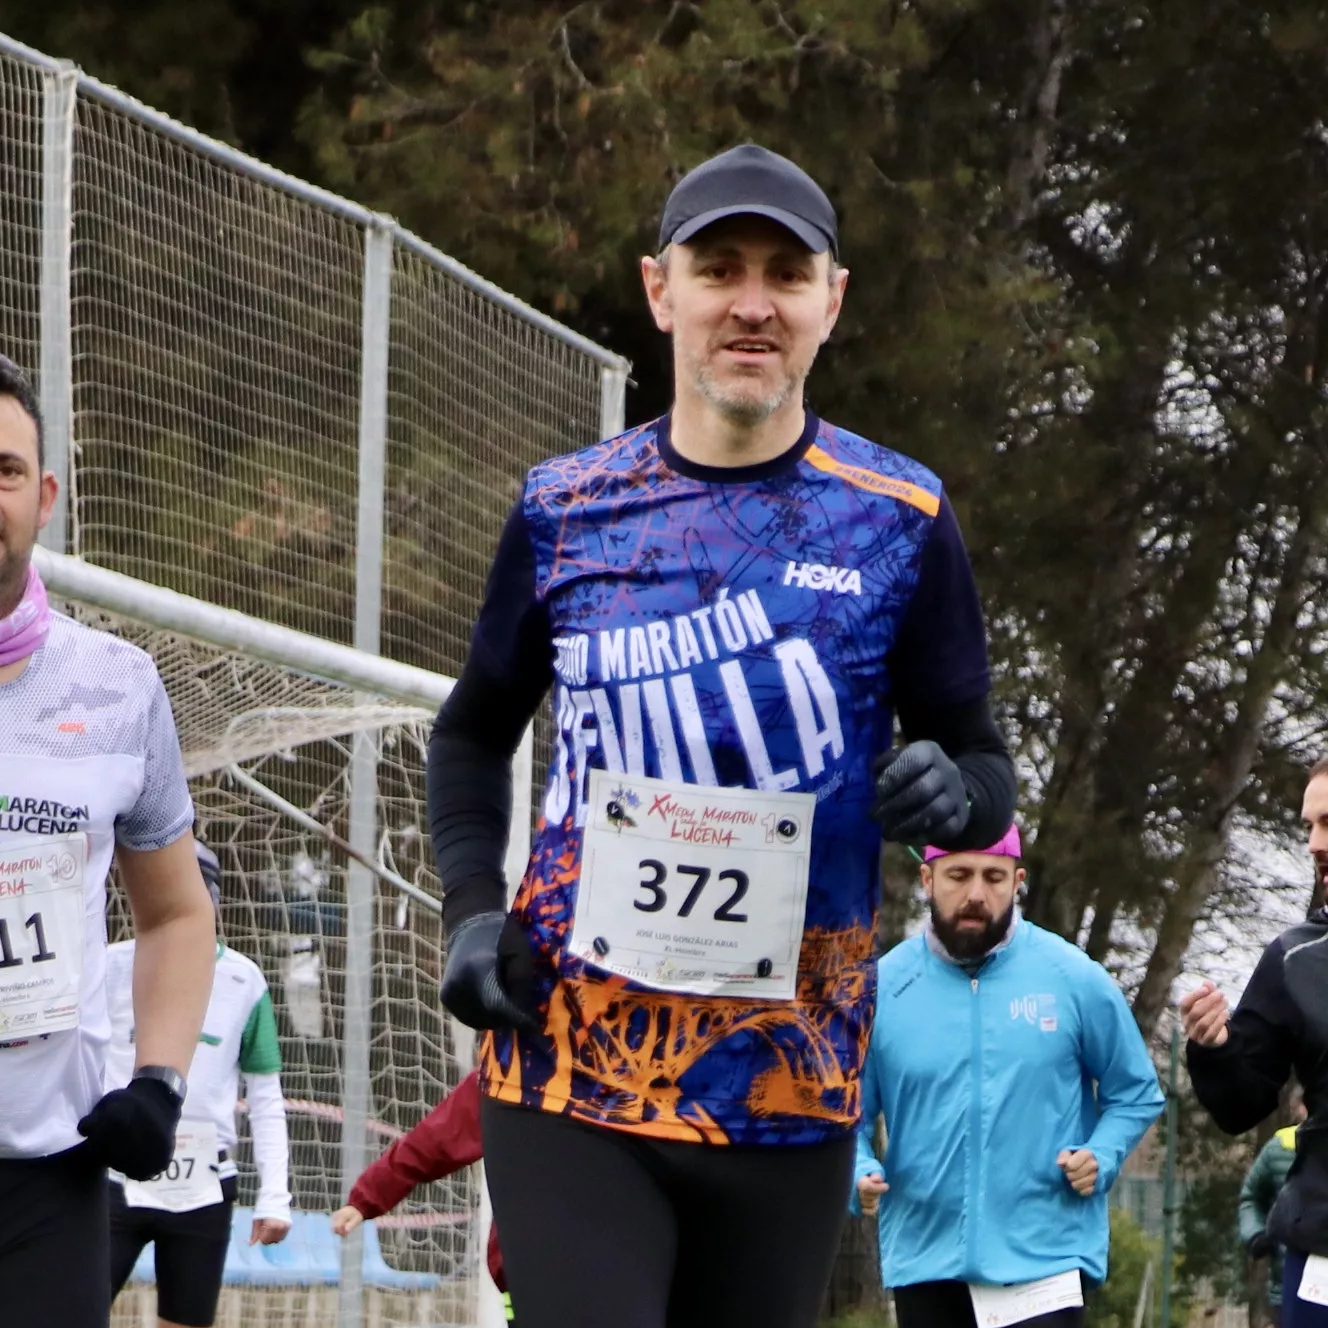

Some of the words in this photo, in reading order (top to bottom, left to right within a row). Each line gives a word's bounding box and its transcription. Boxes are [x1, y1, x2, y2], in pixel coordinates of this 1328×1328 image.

[783, 560, 862, 596] HOKA
[600, 587, 774, 682] MARATÓN
[647, 793, 672, 822] X
[670, 820, 742, 848] LUCENA
[633, 859, 749, 923] 372
[715, 940, 739, 949] ARIAS
